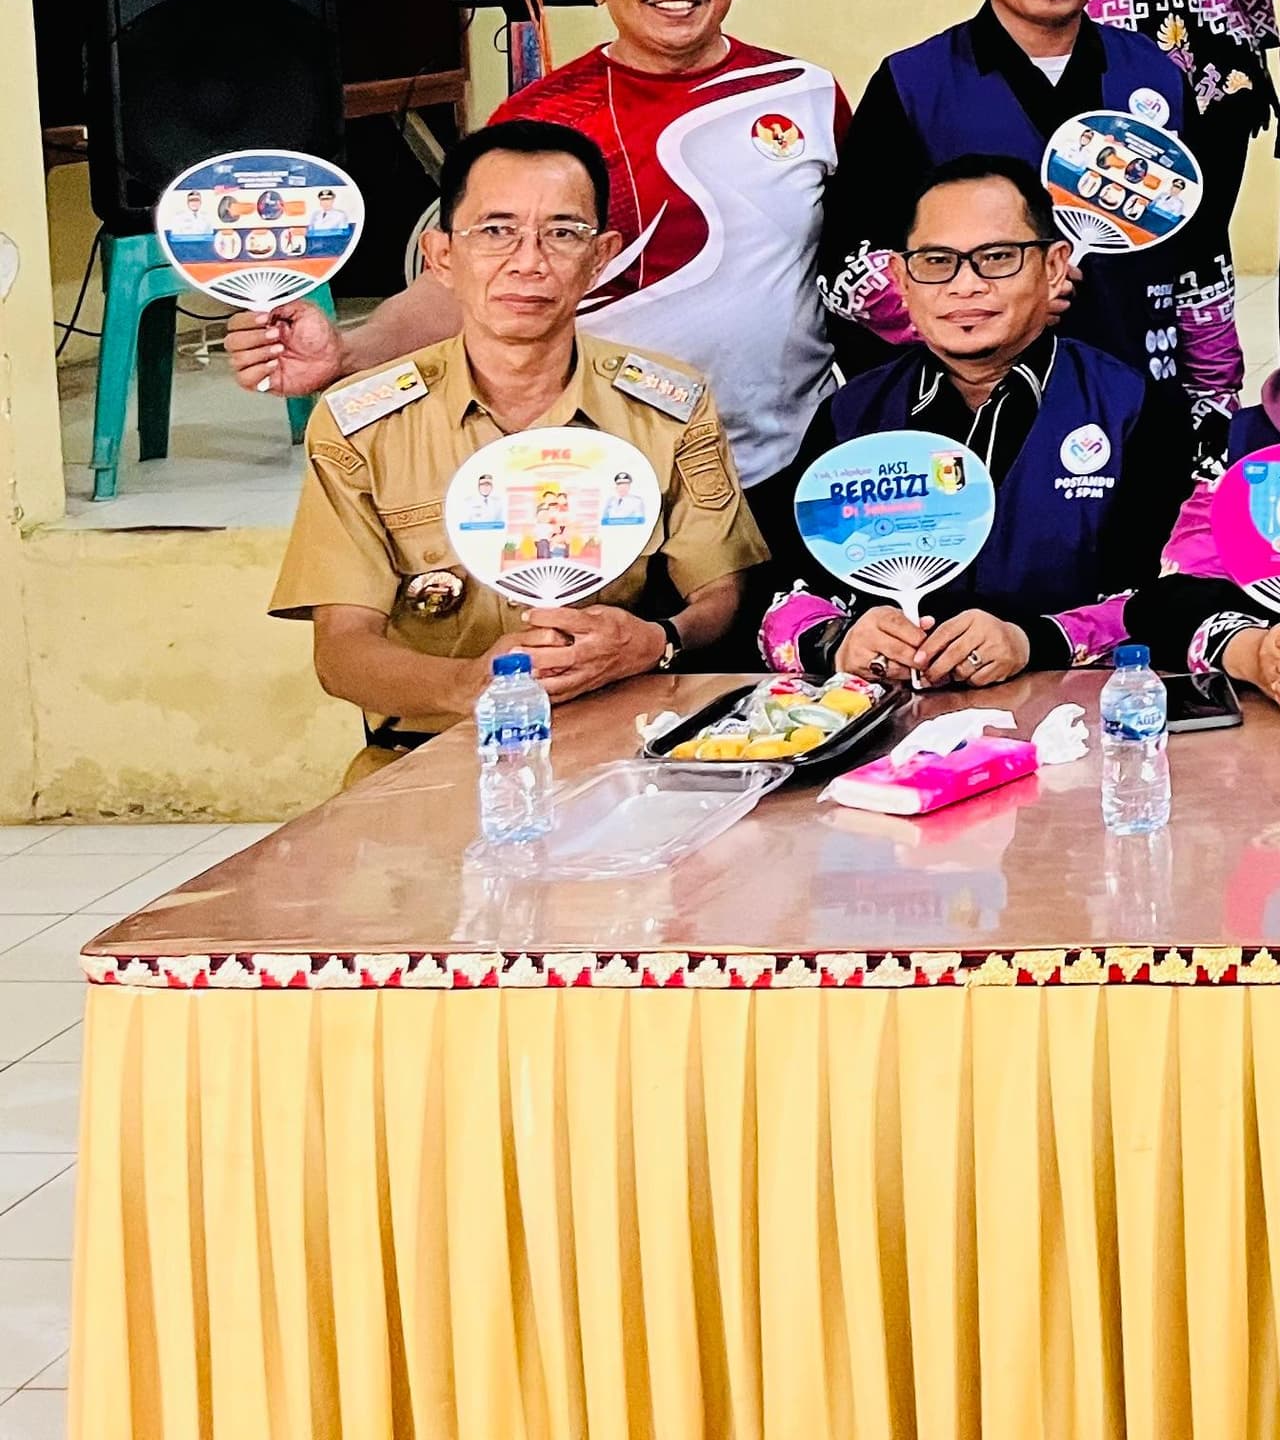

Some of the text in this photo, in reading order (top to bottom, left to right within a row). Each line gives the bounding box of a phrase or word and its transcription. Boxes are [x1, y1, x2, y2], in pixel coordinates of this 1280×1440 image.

[879, 461, 908, 476] AKSI
[830, 473, 929, 505] BERGIZI
[1054, 475, 1115, 489] POSYANDU
[1064, 487, 1104, 499] 6 SPM
